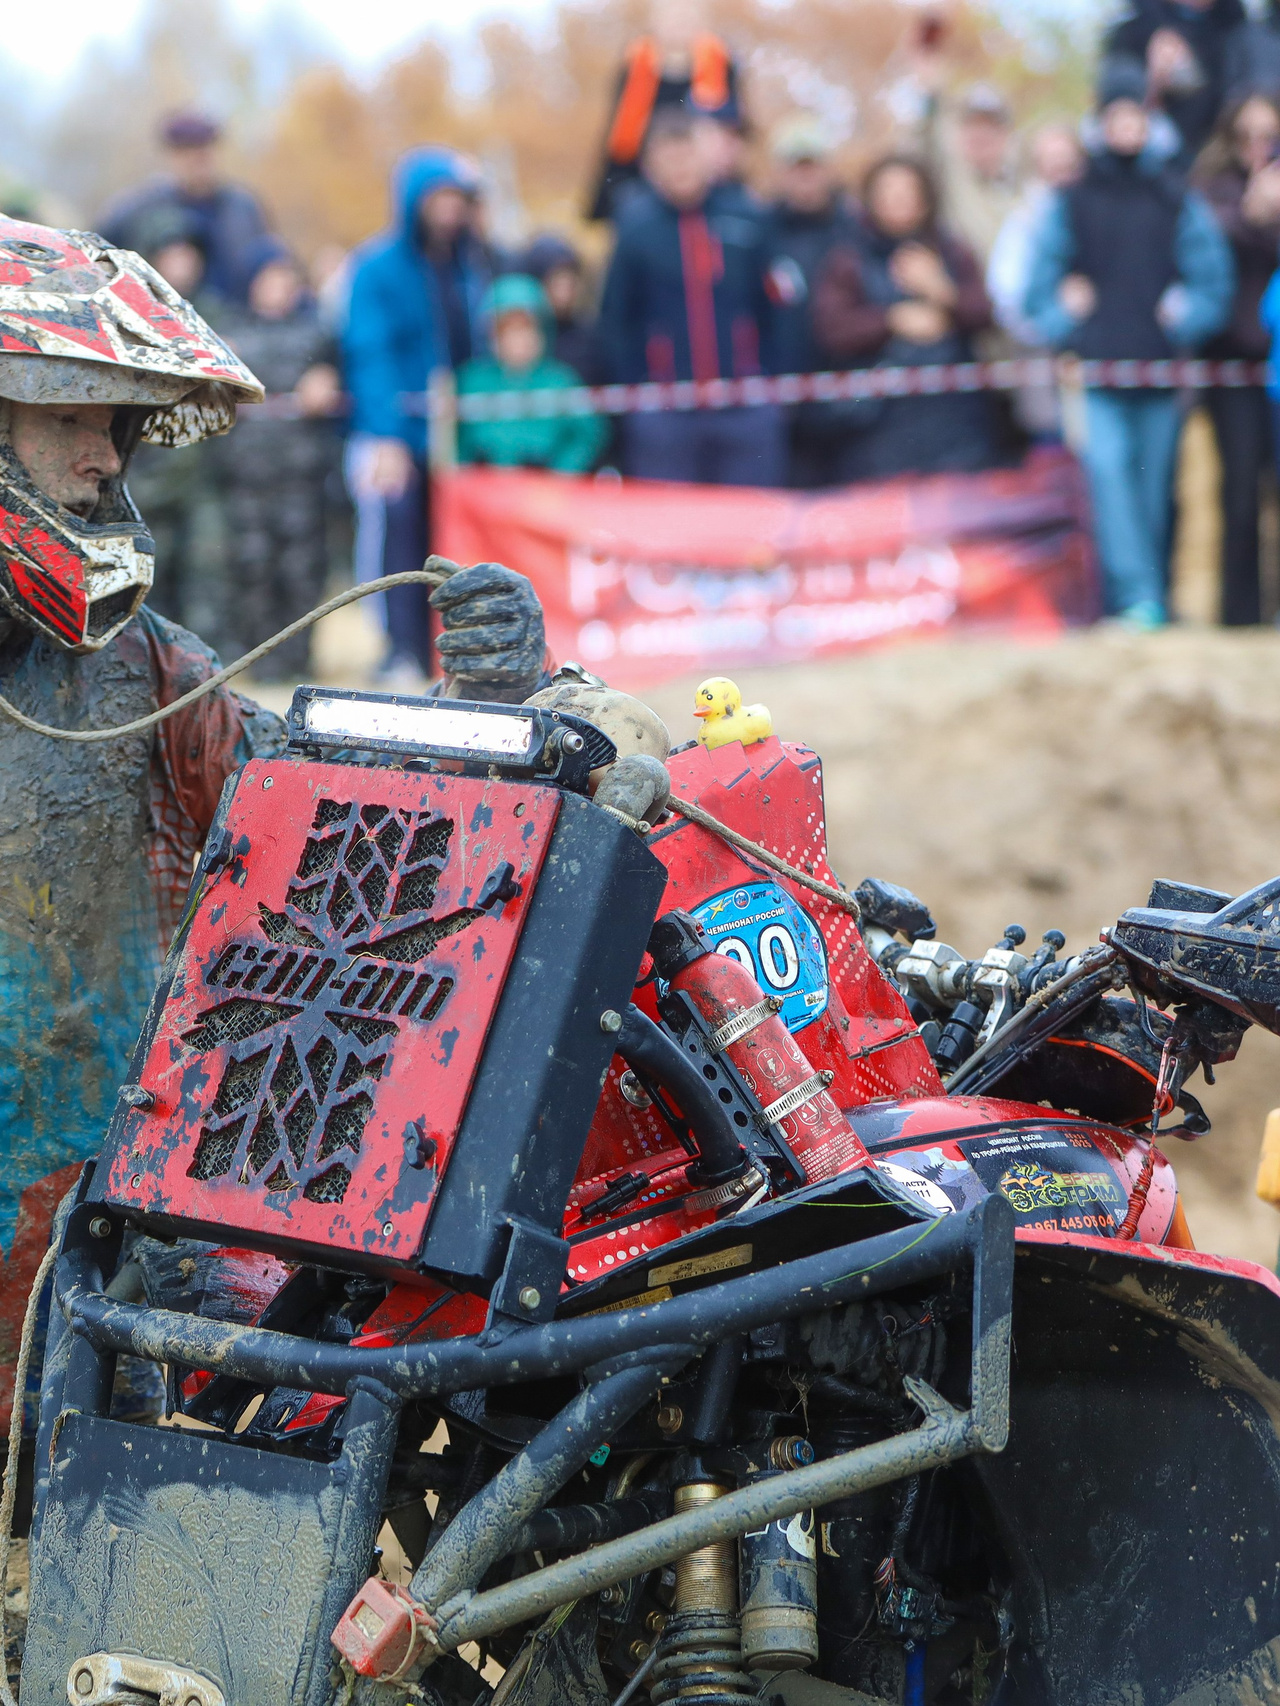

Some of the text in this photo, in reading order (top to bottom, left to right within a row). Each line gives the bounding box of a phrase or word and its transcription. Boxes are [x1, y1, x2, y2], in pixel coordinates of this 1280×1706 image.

[706, 906, 786, 936] ЧЕМПИОНАТ РОССИИ
[987, 1133, 1044, 1146] ЧЕМПИОНАТ РОССИИ
[1070, 1138, 1093, 1149] 2025
[1061, 1216, 1083, 1230] 445
[1098, 1213, 1115, 1228] 04
